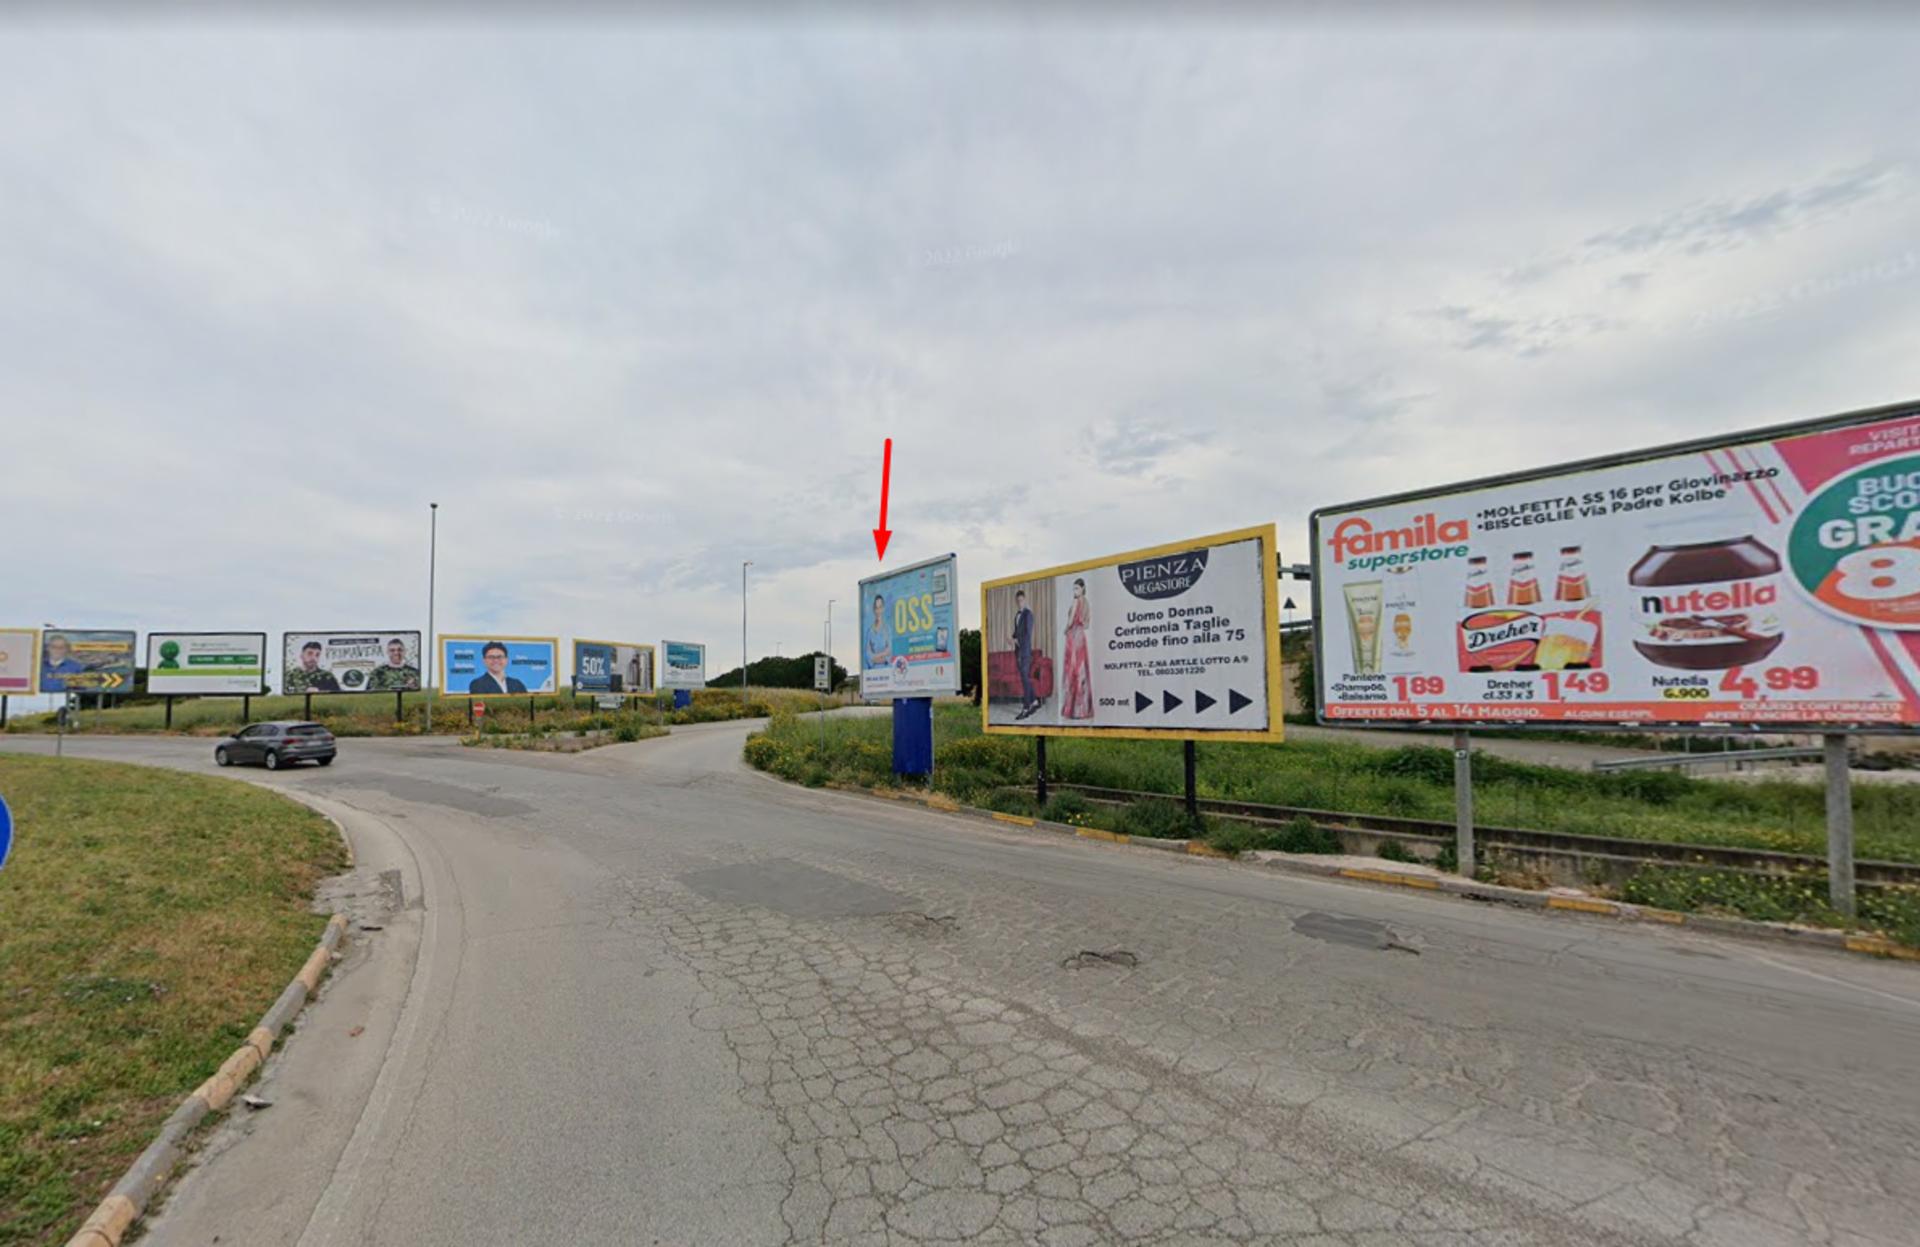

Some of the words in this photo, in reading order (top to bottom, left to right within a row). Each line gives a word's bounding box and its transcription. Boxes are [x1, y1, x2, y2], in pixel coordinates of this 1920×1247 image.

[1582, 491, 1605, 505] SS
[1609, 488, 1628, 501] 16
[1632, 484, 1664, 500] per
[1667, 467, 1779, 492] Giovinazzo
[1578, 502, 1607, 519] Via
[1611, 496, 1664, 514] Padre
[1669, 487, 1726, 505] Kolbe
[1327, 512, 1470, 563] famila
[1347, 544, 1470, 572] superstore
[1121, 557, 1206, 583] PIENZA
[1133, 576, 1192, 595] MEGASTORE
[1641, 582, 1777, 614] nutella
[894, 593, 934, 635] OSS
[1127, 610, 1164, 623] Uomo
[1168, 605, 1213, 618] Donna
[1114, 622, 1180, 637] Cerimonia
[1184, 615, 1230, 631] Taglie
[1467, 619, 1540, 649] Dreher
[1108, 637, 1159, 651] Comode
[1162, 635, 1189, 646] fino
[1193, 632, 1221, 644] alla
[1225, 629, 1245, 642] 75
[582, 656, 605, 676] 50%
[1200, 656, 1231, 665] LOTTO
[1137, 669, 1153, 677] TEL.
[1342, 673, 1387, 682] Pantene
[1651, 674, 1709, 687] Nutella
[1486, 679, 1534, 690] Dreher
[1099, 698, 1116, 706] 500
[1416, 704, 1429, 717] 5
[1430, 708, 1447, 717] AL
[1453, 704, 1474, 717] 14
